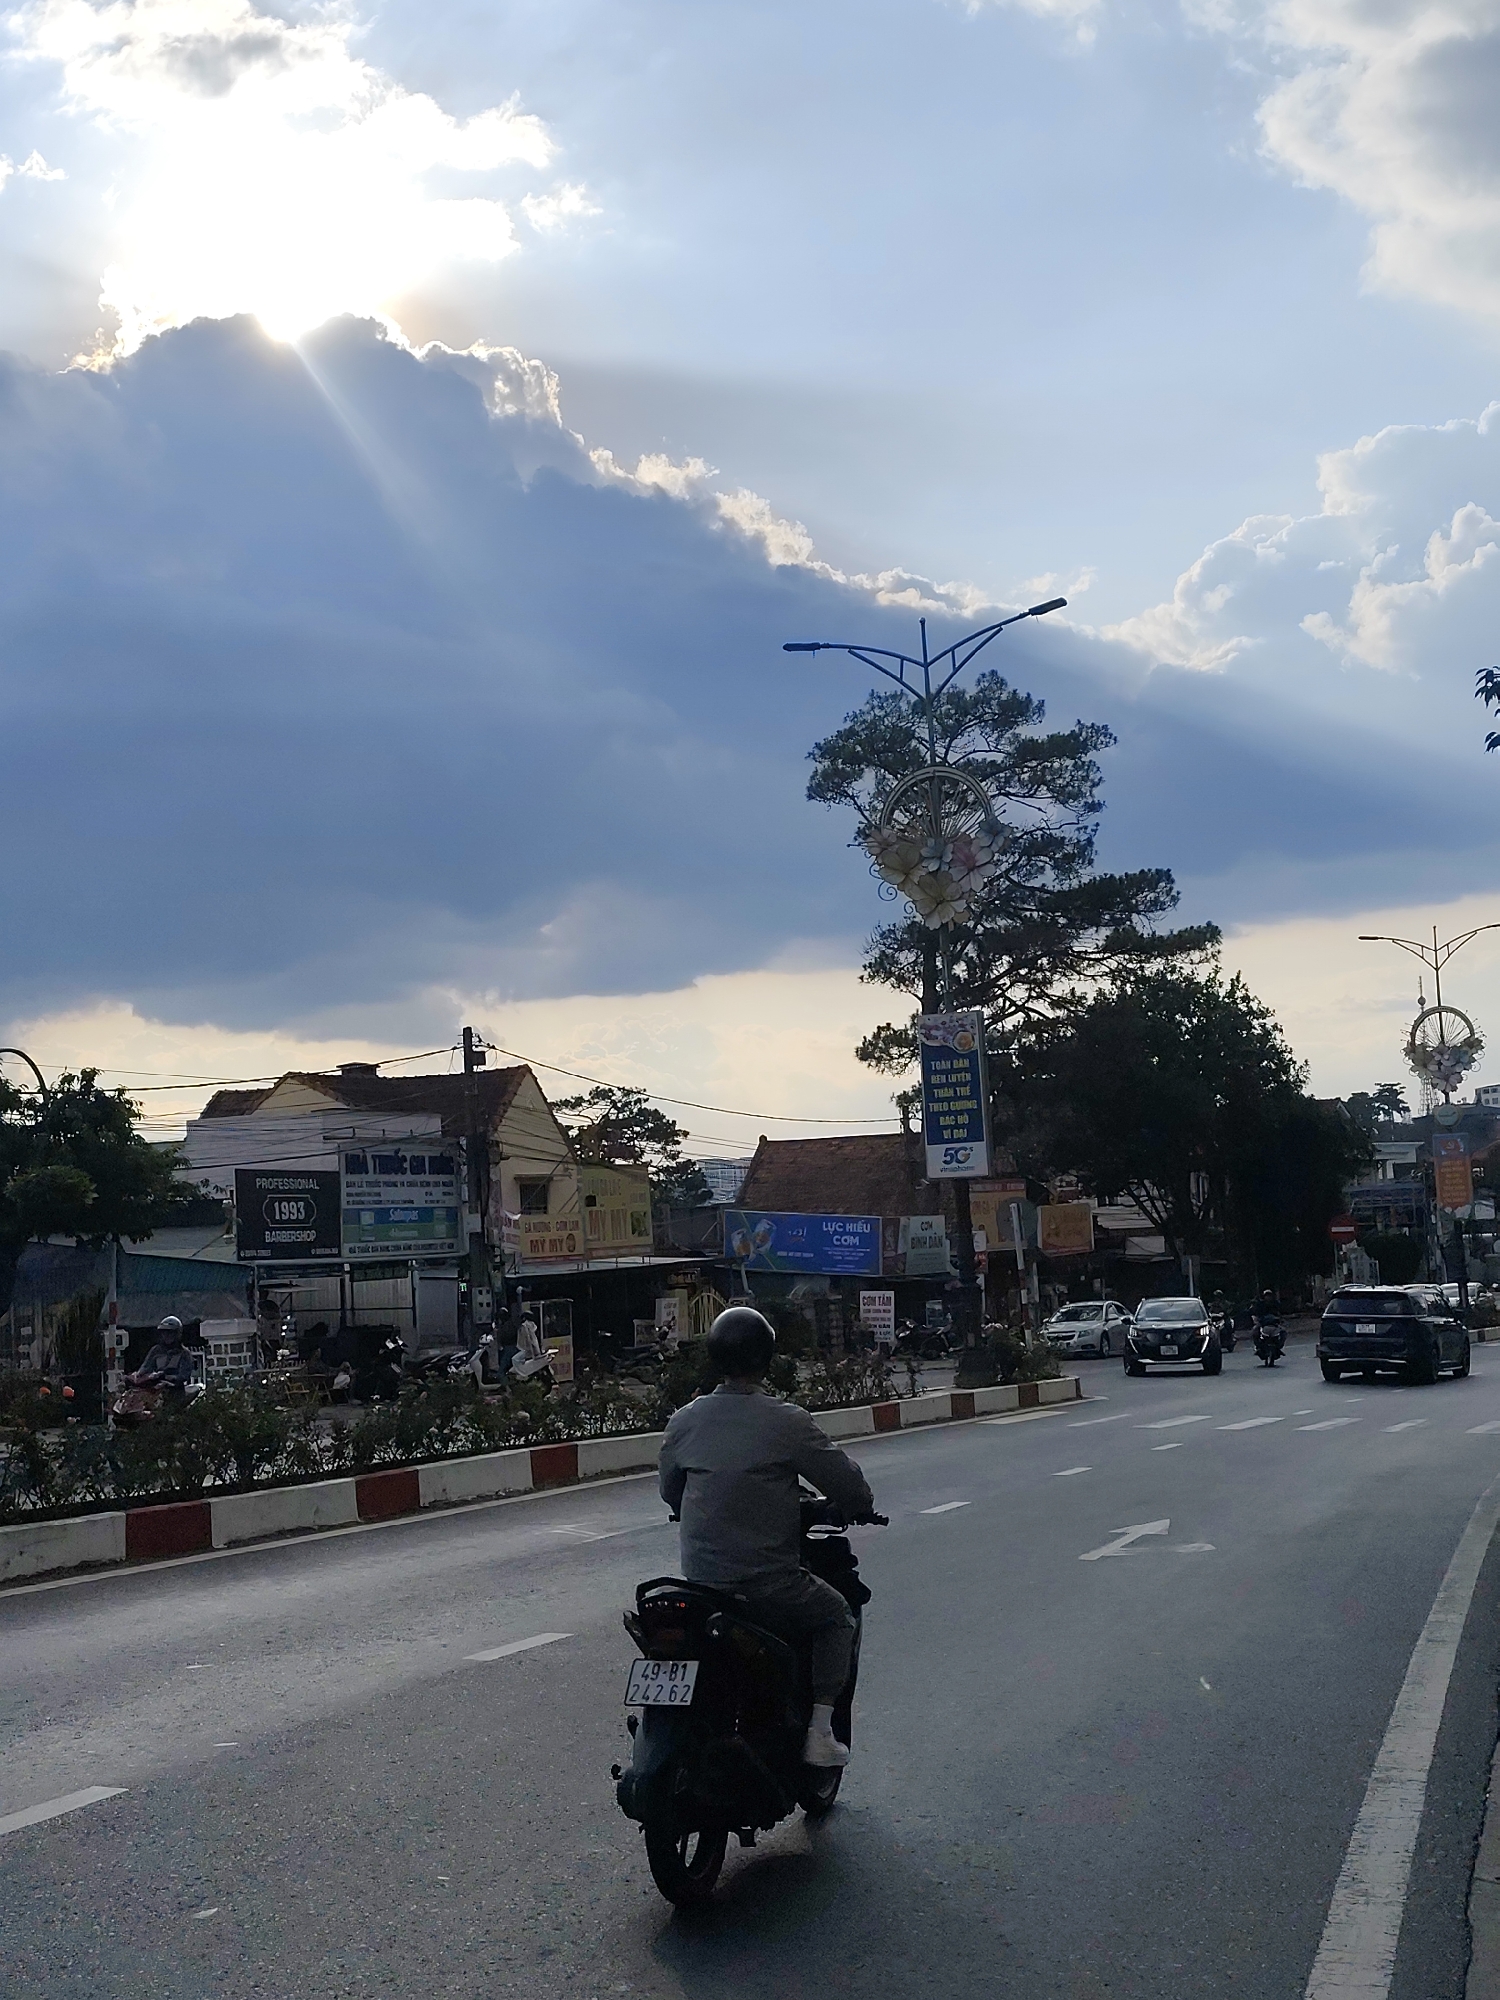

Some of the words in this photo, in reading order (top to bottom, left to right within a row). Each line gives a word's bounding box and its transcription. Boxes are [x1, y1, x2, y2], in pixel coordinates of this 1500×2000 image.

[930, 1059, 951, 1071] TOÀN
[953, 1057, 970, 1069] DÂN
[933, 1086, 954, 1099] THÂN
[928, 1101, 949, 1112] THEO
[939, 1114, 955, 1126] BÁC
[957, 1112, 969, 1124] HỒ
[371, 1148, 408, 1175] THUỐC
[255, 1177, 321, 1190] PROFESSIONAL
[273, 1200, 306, 1221] 1993
[822, 1221, 844, 1235] LỰC
[920, 1220, 933, 1231] CƠM
[264, 1229, 317, 1243] BARBERSHOP
[833, 1235, 860, 1246] CƠM
[910, 1233, 927, 1249] BÌNH
[928, 1232, 943, 1249] DÂN
[530, 1236, 546, 1253] MỸ
[549, 1235, 564, 1252] MỸ
[862, 1295, 877, 1306] CƠM
[878, 1293, 892, 1306] TẤM
[641, 1662, 688, 1682] 49-B1
[629, 1683, 691, 1703] 242.62
